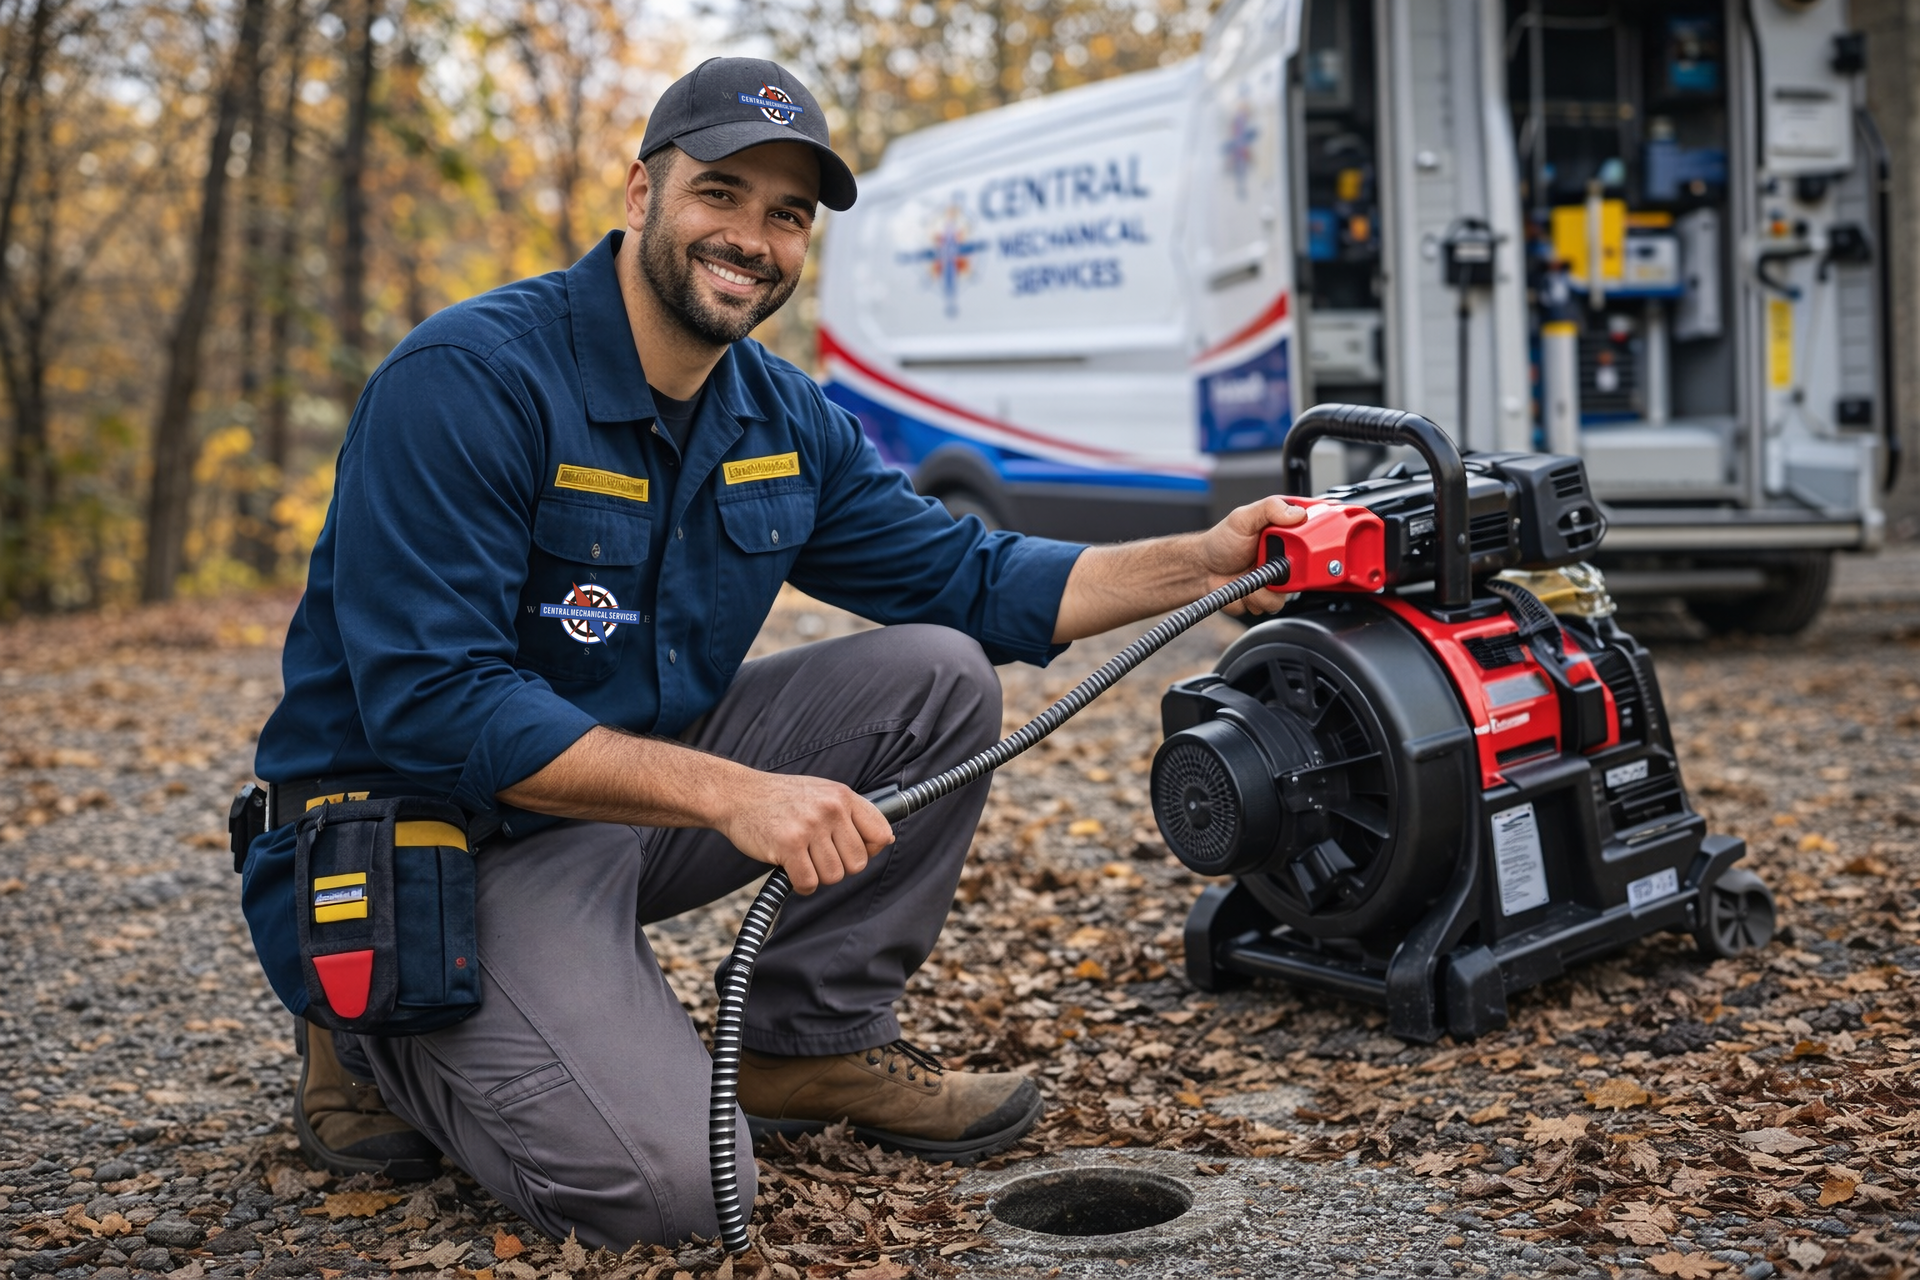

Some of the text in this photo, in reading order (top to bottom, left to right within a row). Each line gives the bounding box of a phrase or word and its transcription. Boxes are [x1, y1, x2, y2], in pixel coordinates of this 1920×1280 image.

[741, 95, 765, 105] CENTRAL
[765, 100, 790, 110] MECHANICAL
[978, 154, 1151, 221] CENTRAL
[998, 215, 1151, 258] MECHANICAL
[1010, 257, 1122, 298] SERVICES
[589, 572, 597, 580] N
[543, 606, 637, 621] CENTRAL MECHANICAL SERVICES
[644, 615, 650, 623] E
[584, 647, 590, 655] S
